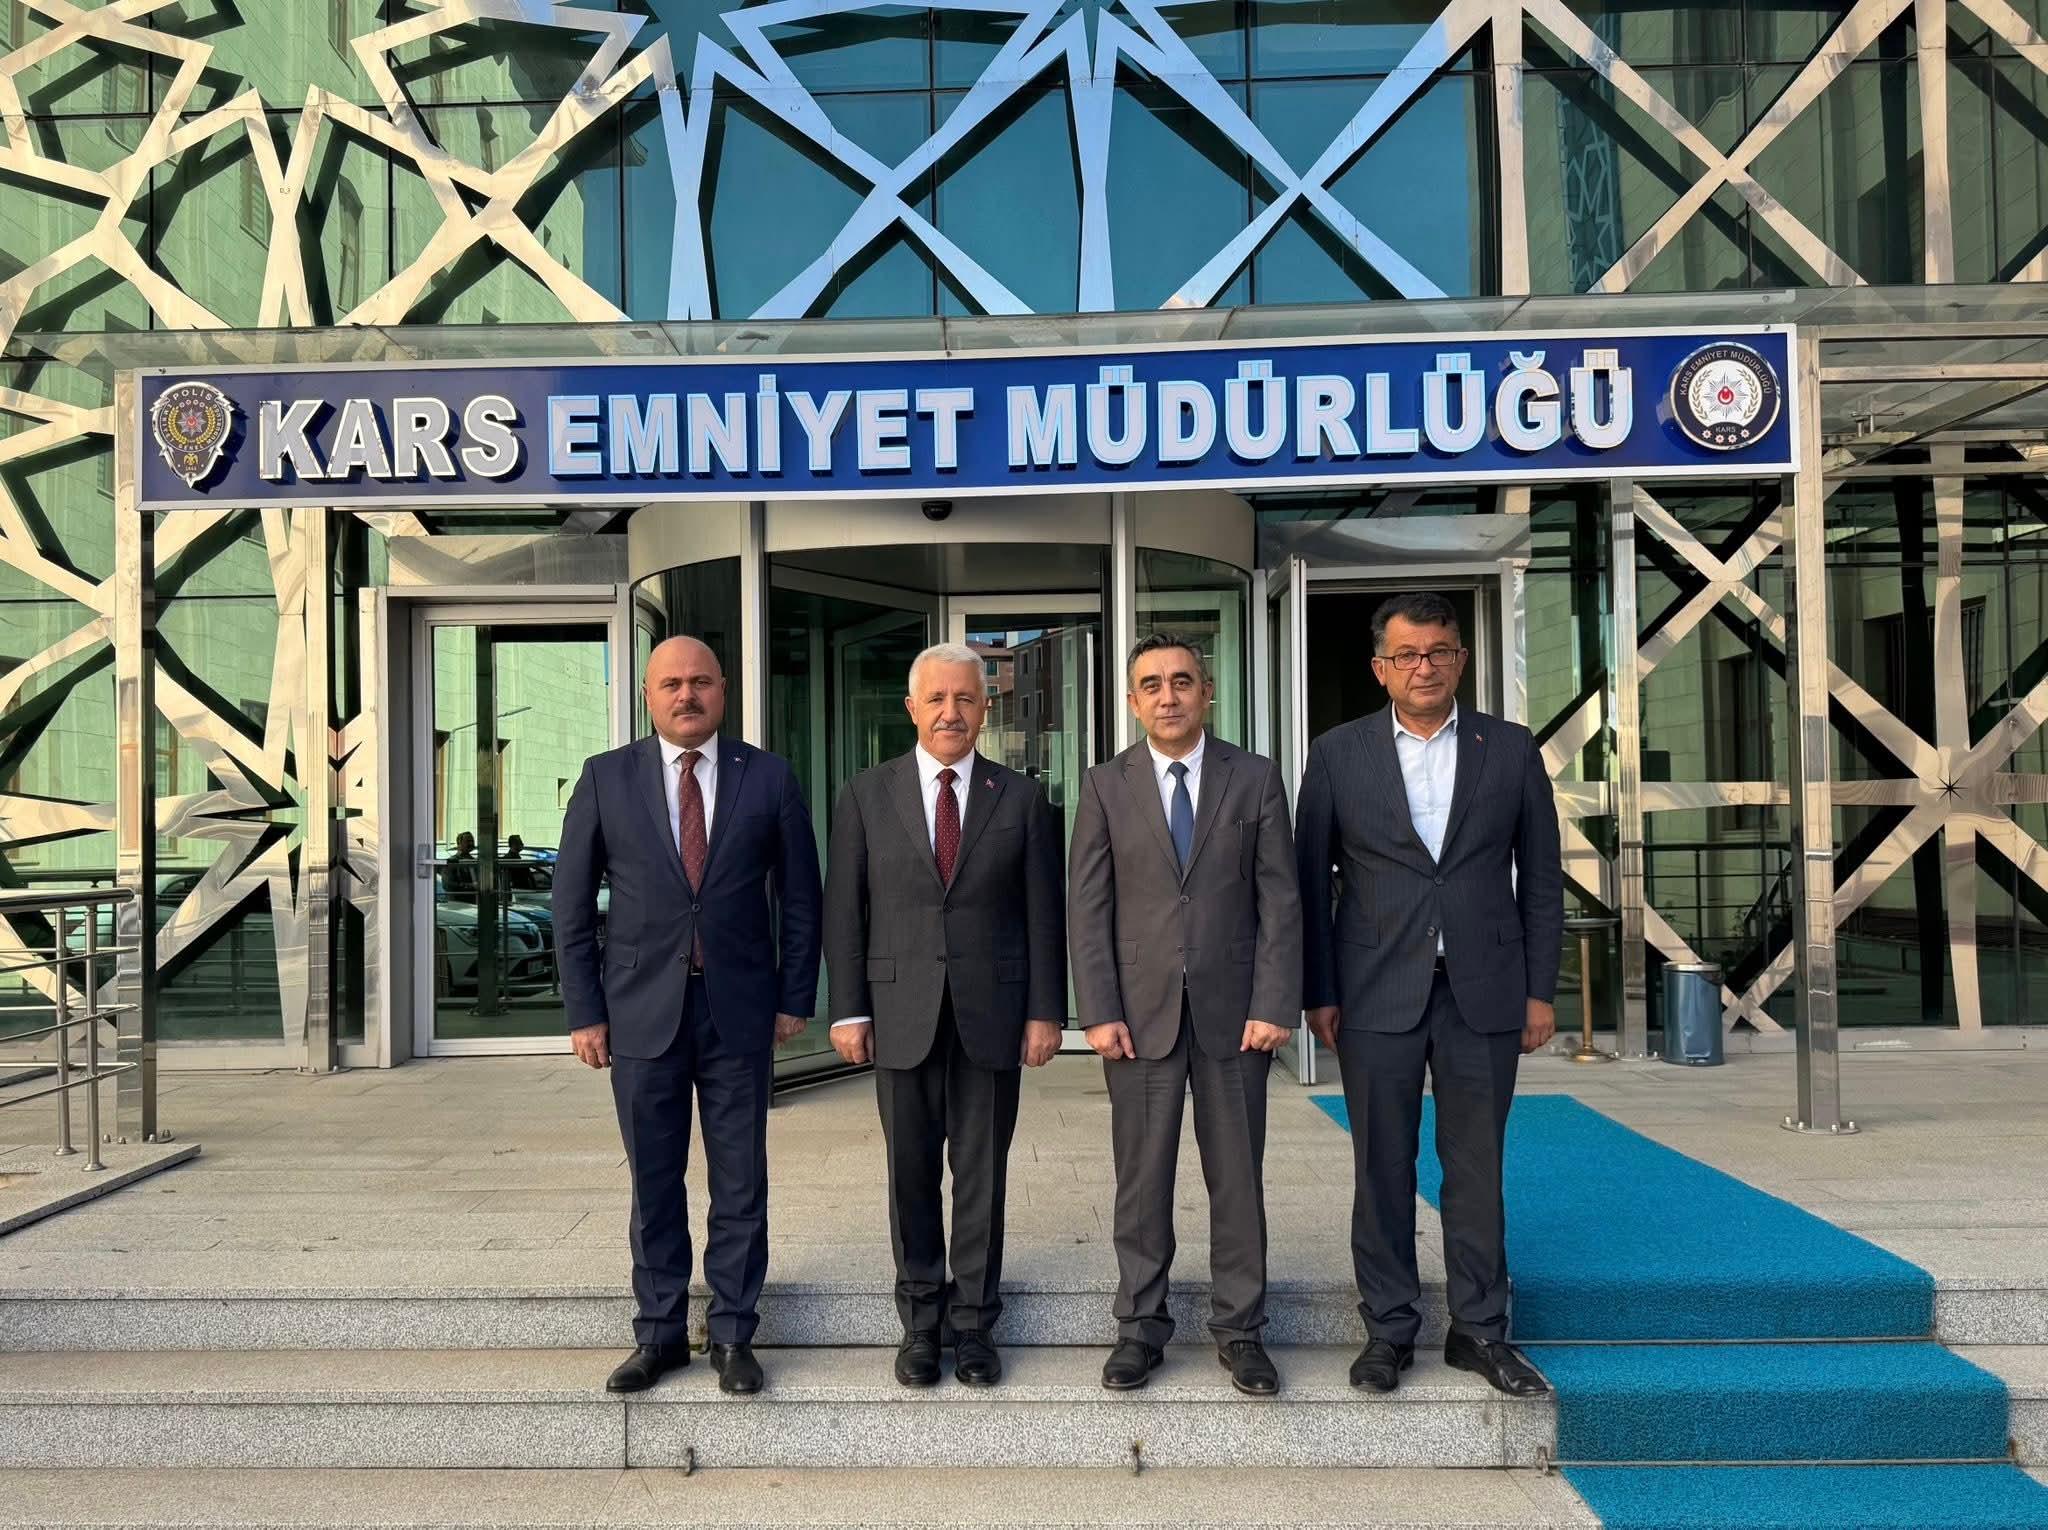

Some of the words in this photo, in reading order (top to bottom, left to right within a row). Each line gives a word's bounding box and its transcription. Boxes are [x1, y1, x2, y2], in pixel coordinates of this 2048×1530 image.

[172, 389, 213, 401] POLİS
[1680, 371, 1693, 395] KARS
[1691, 350, 1728, 370] EMNİYET
[258, 394, 520, 480] KARS
[547, 374, 975, 476] EMNİYET
[1007, 349, 1633, 467] MÜDÜRLÜĞÜ
